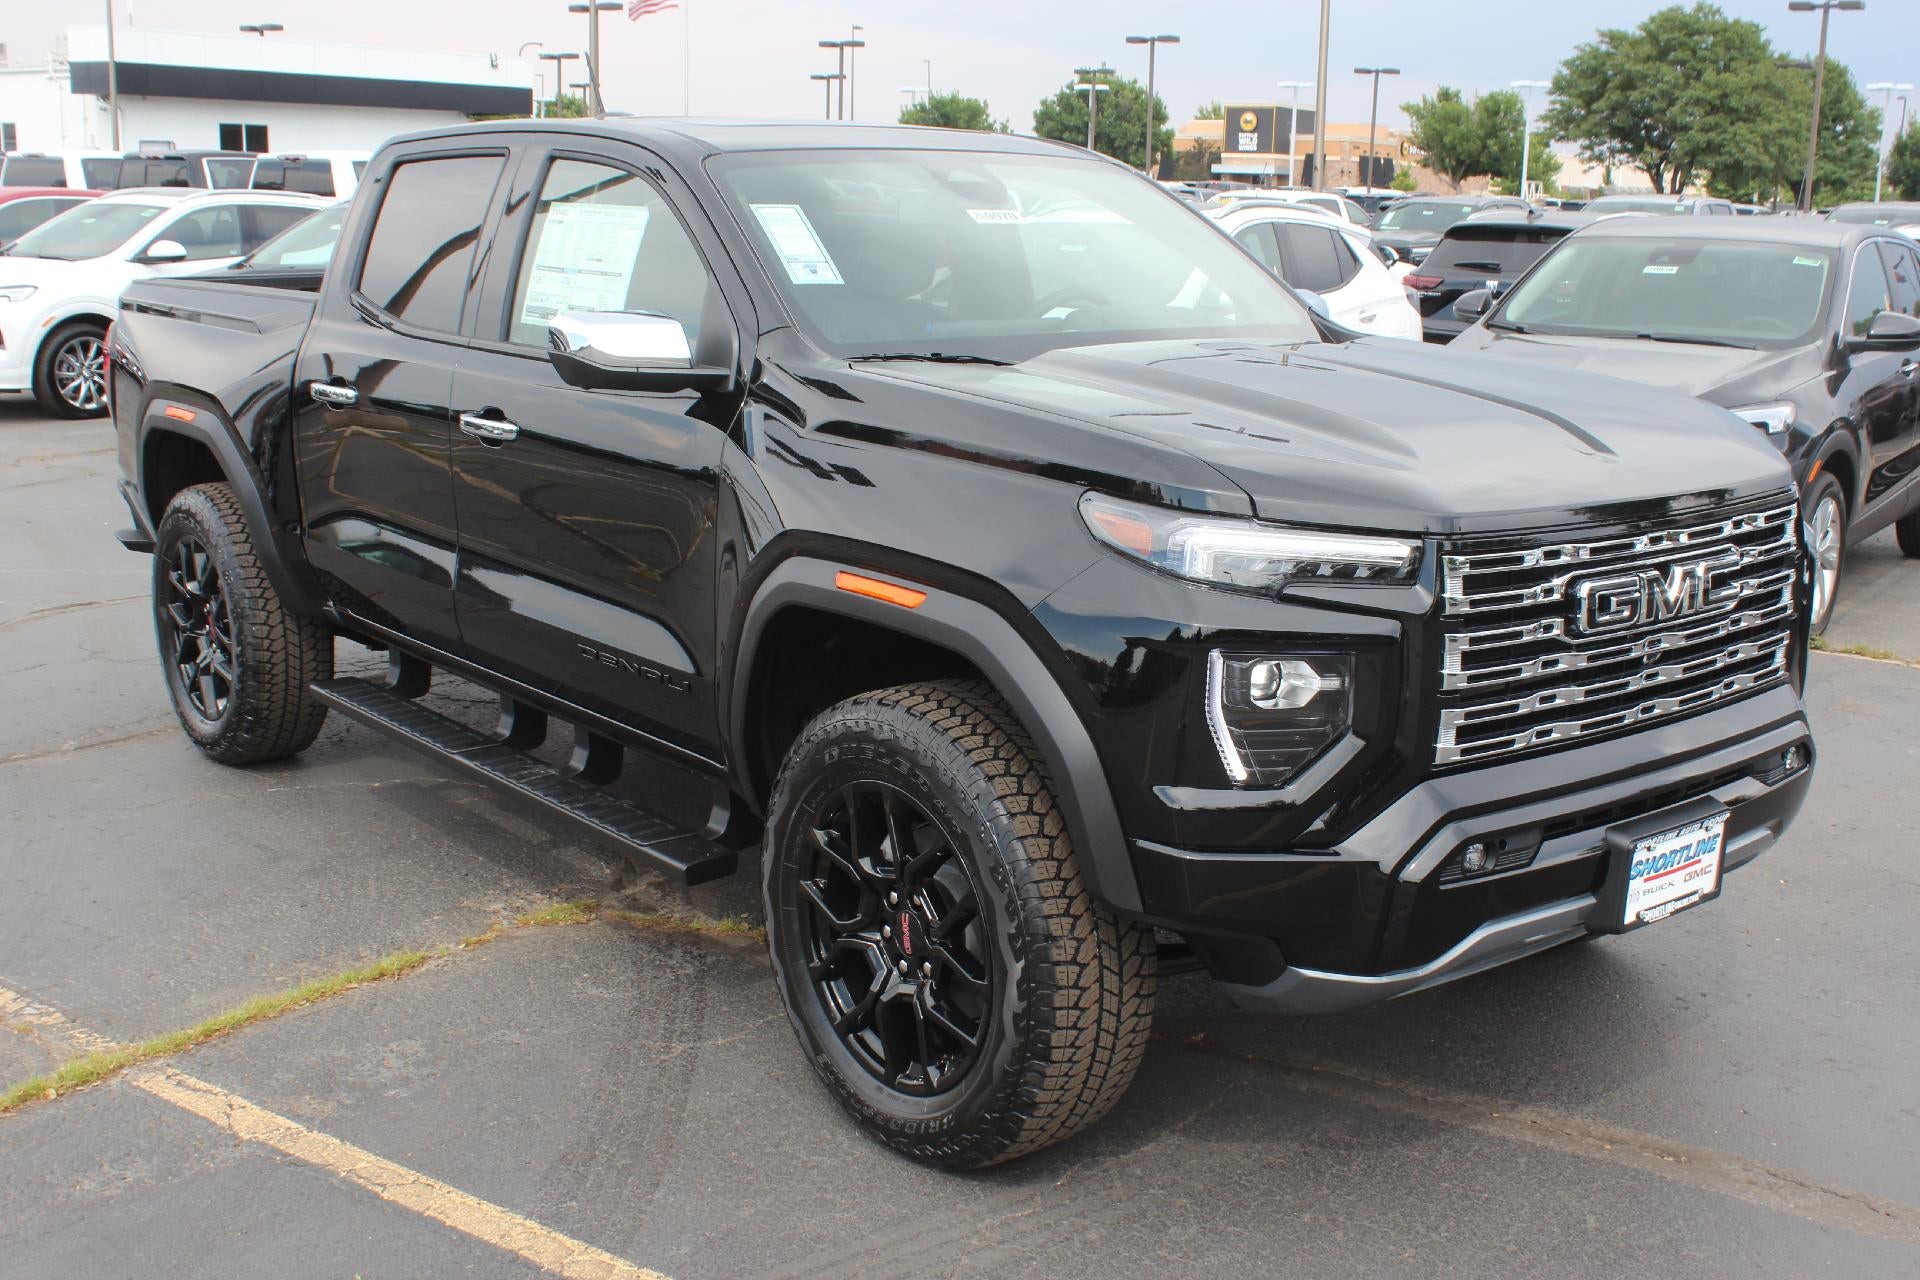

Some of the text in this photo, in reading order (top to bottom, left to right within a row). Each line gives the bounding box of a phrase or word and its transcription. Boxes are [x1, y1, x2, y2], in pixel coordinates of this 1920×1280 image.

[1238, 137, 1258, 145] WILD
[1580, 557, 1741, 634] GMC
[576, 643, 692, 695] DENALI
[1635, 812, 1730, 852] SHORTLINE AUTO GROUP
[1629, 833, 1721, 881] SHORTLINE
[1642, 864, 1713, 896] BUICK GMC
[1642, 900, 1677, 922] SHORTLINE
[901, 912, 912, 955] GMC
